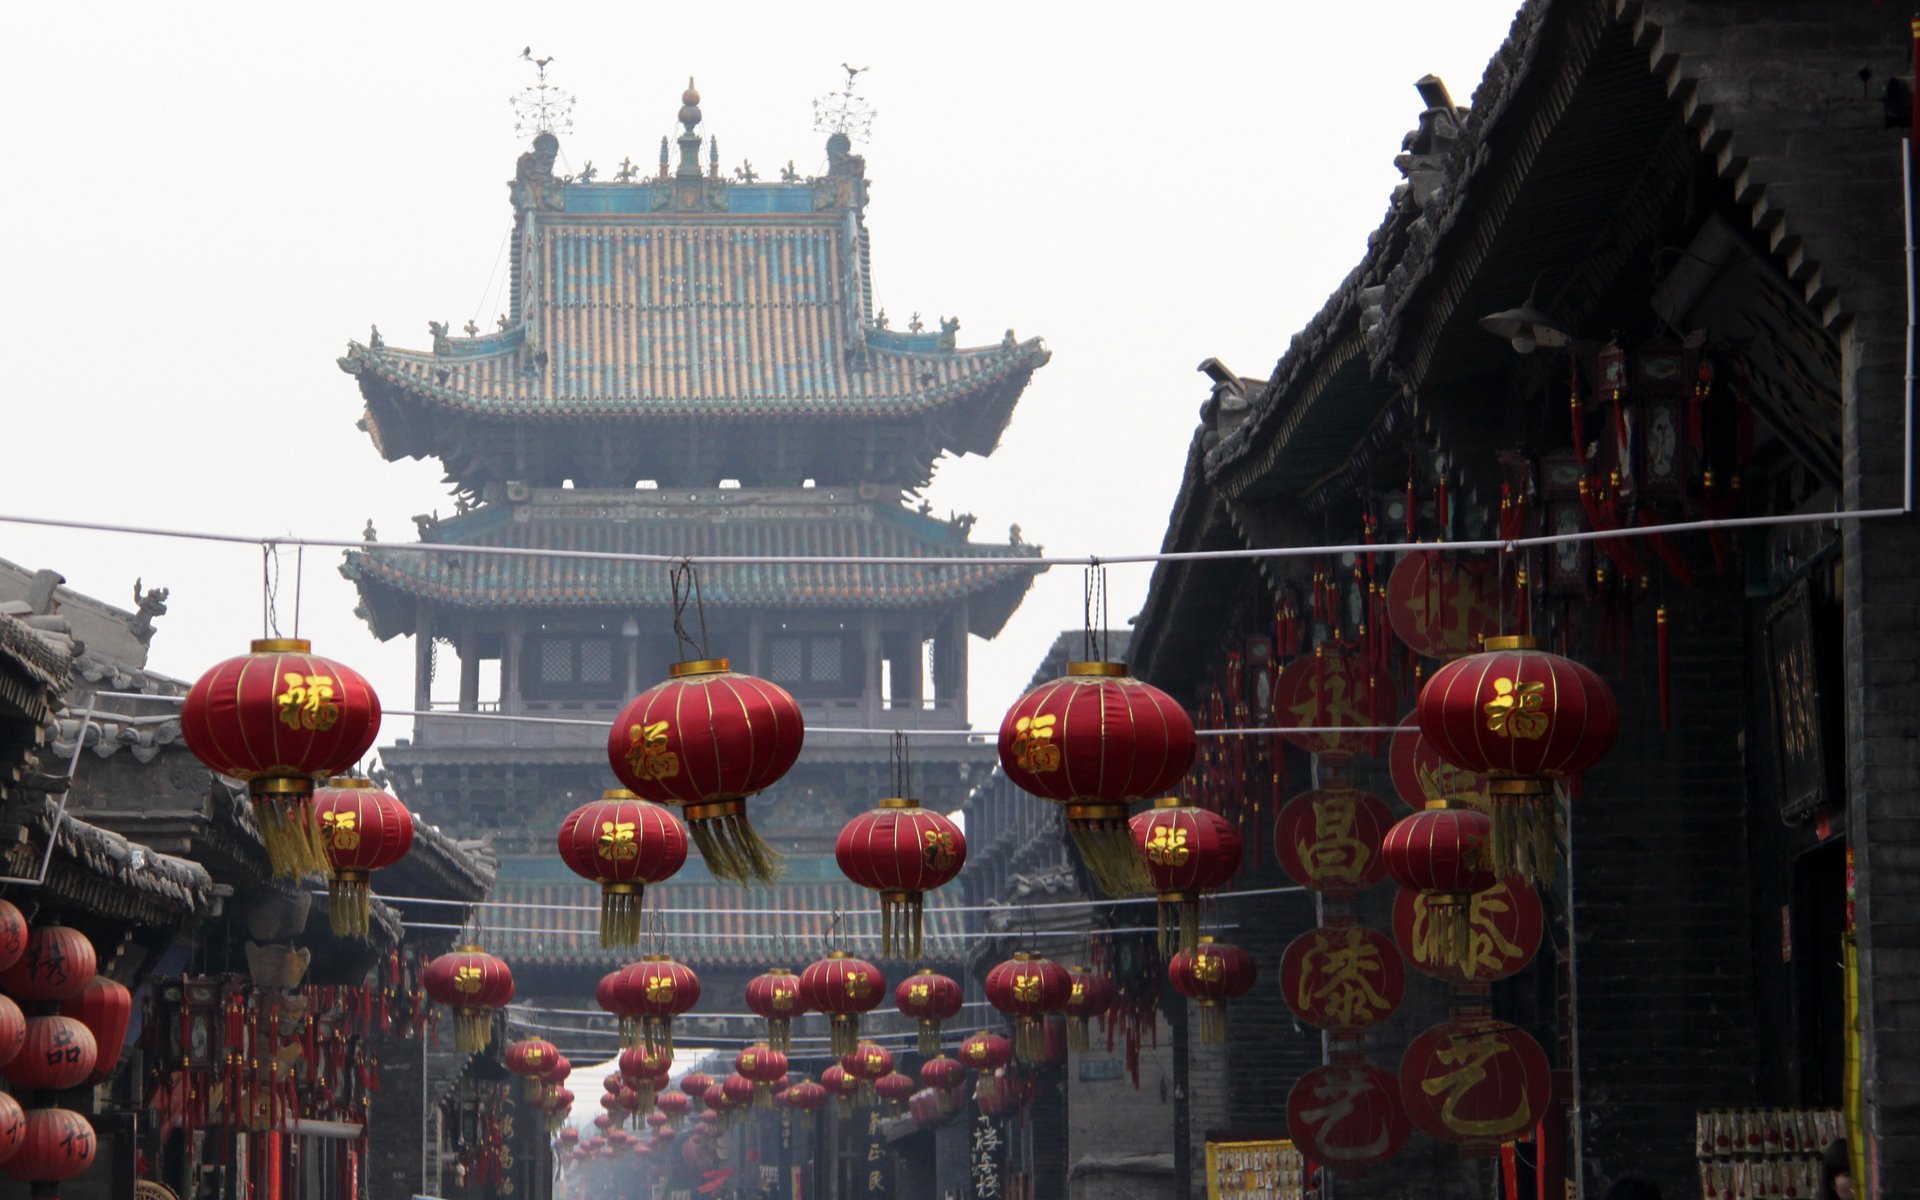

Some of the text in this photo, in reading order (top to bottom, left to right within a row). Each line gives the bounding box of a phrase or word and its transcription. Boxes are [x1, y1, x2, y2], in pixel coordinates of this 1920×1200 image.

[278, 672, 338, 731] 福
[1483, 677, 1549, 740] 福
[627, 721, 680, 780] 福
[1011, 714, 1060, 773] 福
[322, 810, 360, 850] 福
[599, 821, 638, 861] 福
[924, 830, 957, 870] 福
[1147, 826, 1189, 868] 福
[454, 966, 481, 993] 福
[846, 971, 871, 998] 福
[1193, 954, 1221, 982] 福
[646, 976, 673, 1003] 福
[772, 988, 793, 1010] 福
[908, 984, 928, 1005] 福
[1012, 975, 1041, 1002] 福
